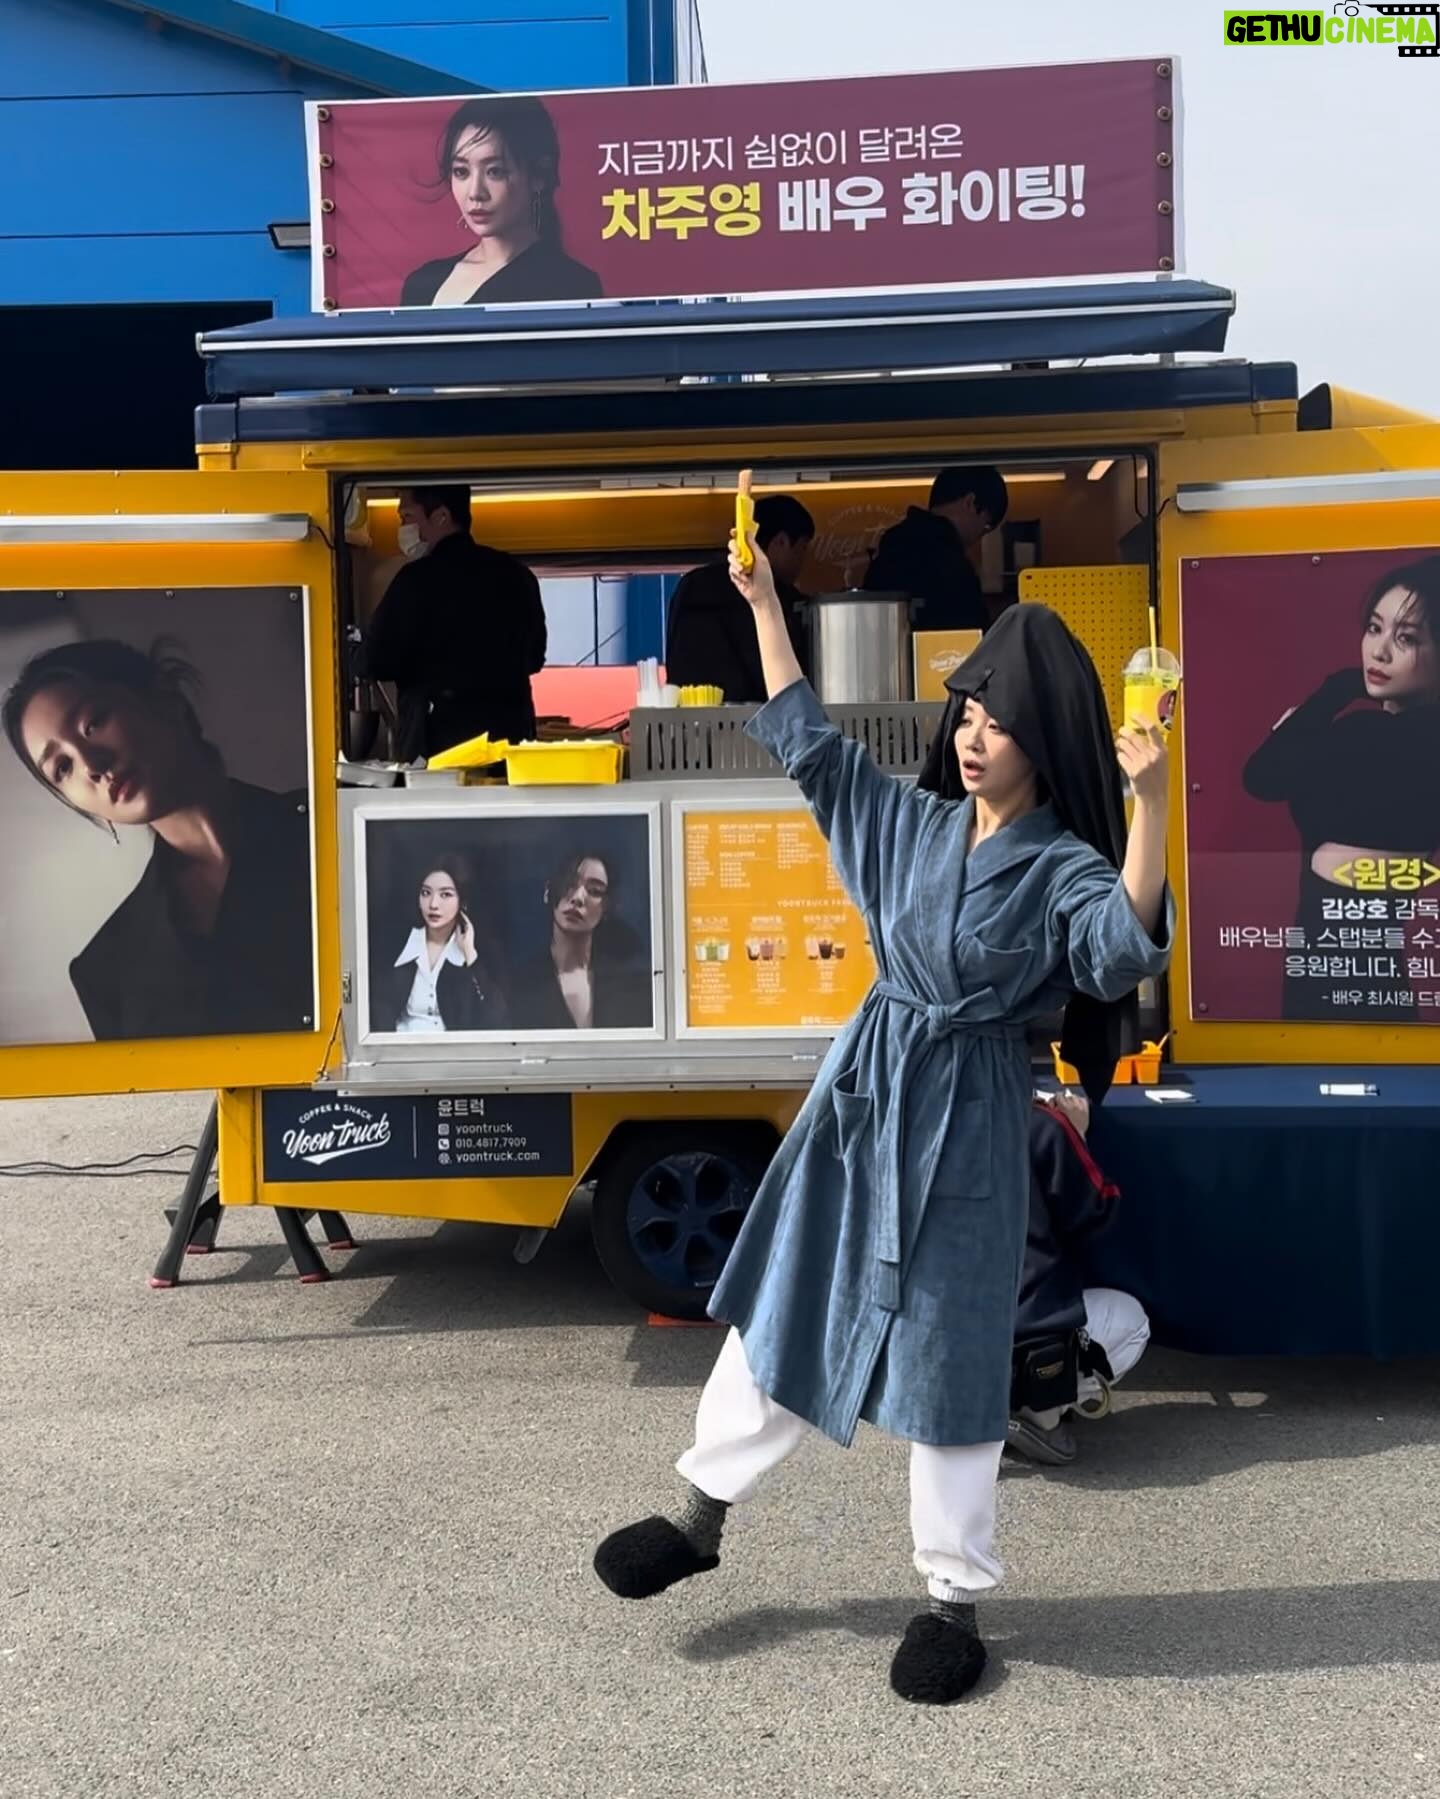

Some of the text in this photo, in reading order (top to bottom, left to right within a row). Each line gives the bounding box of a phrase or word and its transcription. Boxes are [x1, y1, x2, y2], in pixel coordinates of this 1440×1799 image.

[597, 123, 964, 176] 지금까지 쉼없이 달려온
[602, 164, 1086, 240] 차주영 배우 화이팅!
[1322, 898, 1389, 920] 김상호
[1219, 926, 1311, 949] 배우님들,
[1317, 927, 1405, 949] 스탭분들
[1285, 955, 1401, 978] 응원합니다.
[1332, 990, 1363, 1006] 배우
[1367, 990, 1414, 1007] 최시원
[299, 1104, 332, 1123] COFFEE
[343, 1104, 373, 1120] SNACK
[437, 1098, 484, 1117] 윤트럭
[455, 1123, 513, 1134] yoontruck
[283, 1128, 336, 1158] Yoon
[455, 1137, 527, 1148] 010.4817.7909
[456, 1151, 540, 1163] yoontruck.com
